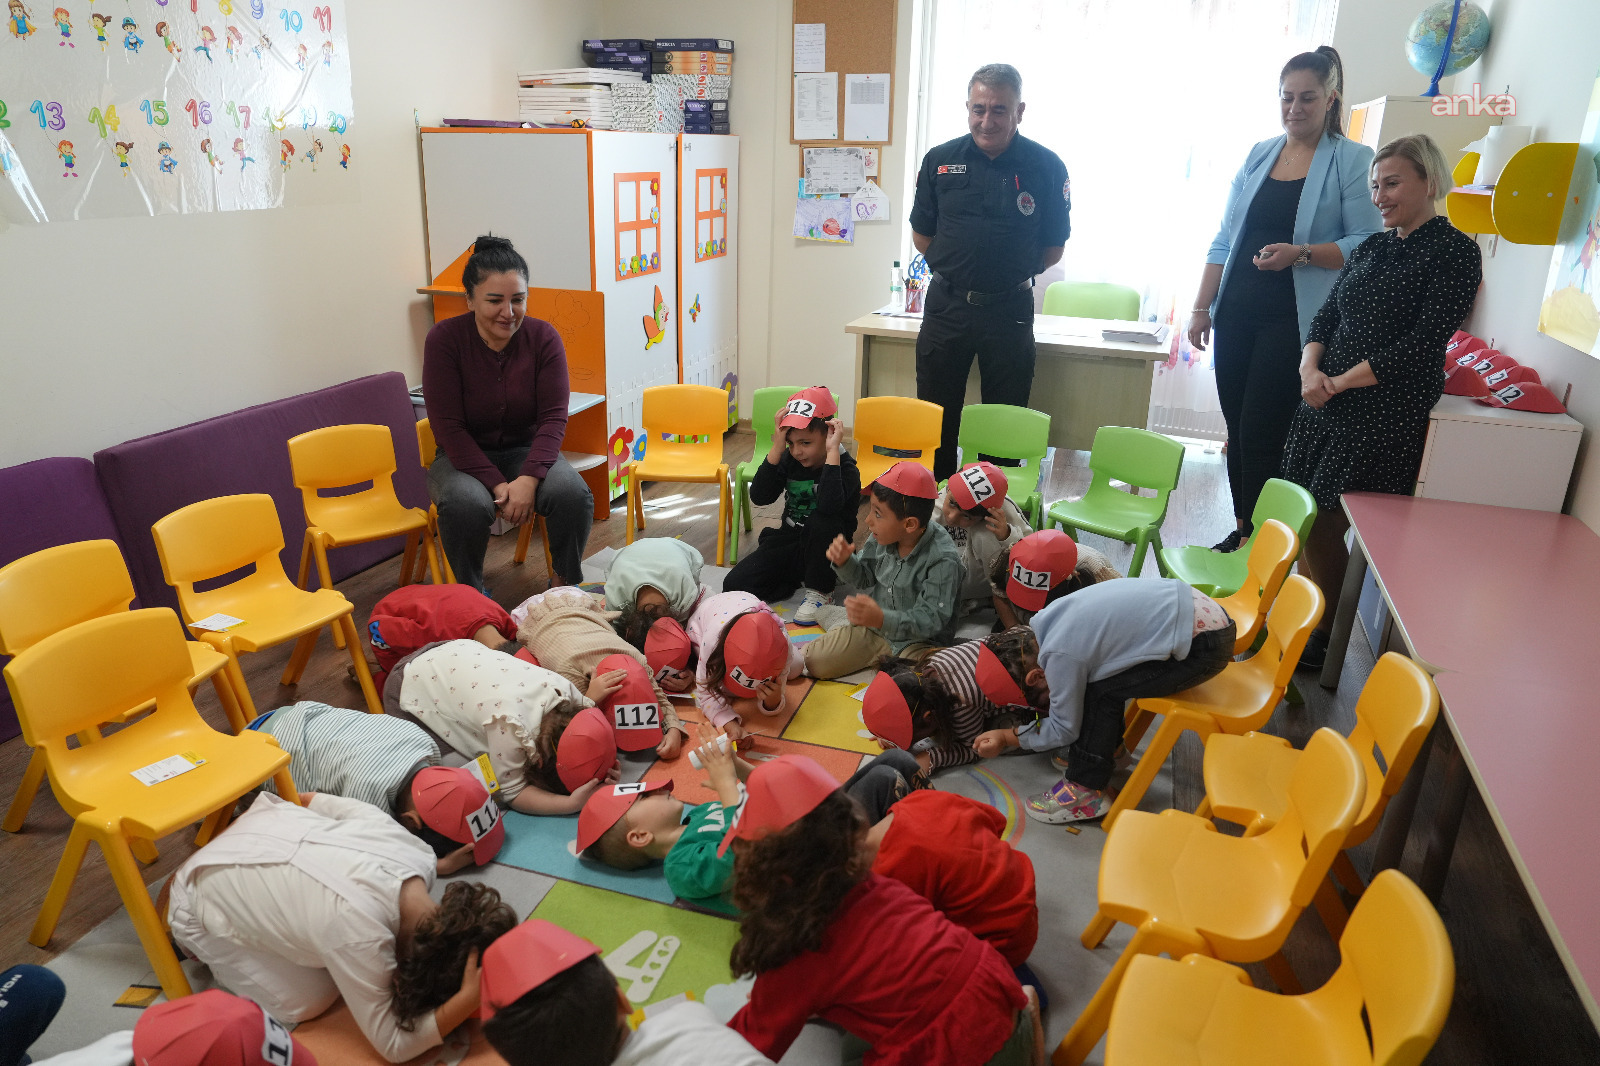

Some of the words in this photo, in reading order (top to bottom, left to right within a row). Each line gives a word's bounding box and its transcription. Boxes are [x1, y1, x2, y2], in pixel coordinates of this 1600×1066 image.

[250, 0, 264, 20] 9
[280, 9, 303, 33] 10
[313, 5, 332, 33] 11
[30, 99, 66, 131] 13
[88, 104, 120, 138] 14
[140, 99, 169, 126] 15
[185, 98, 213, 129] 16
[226, 101, 251, 130] 17
[327, 110, 347, 134] 20
[963, 467, 992, 503] 112
[1013, 564, 1048, 589] 112
[616, 705, 659, 727] 112
